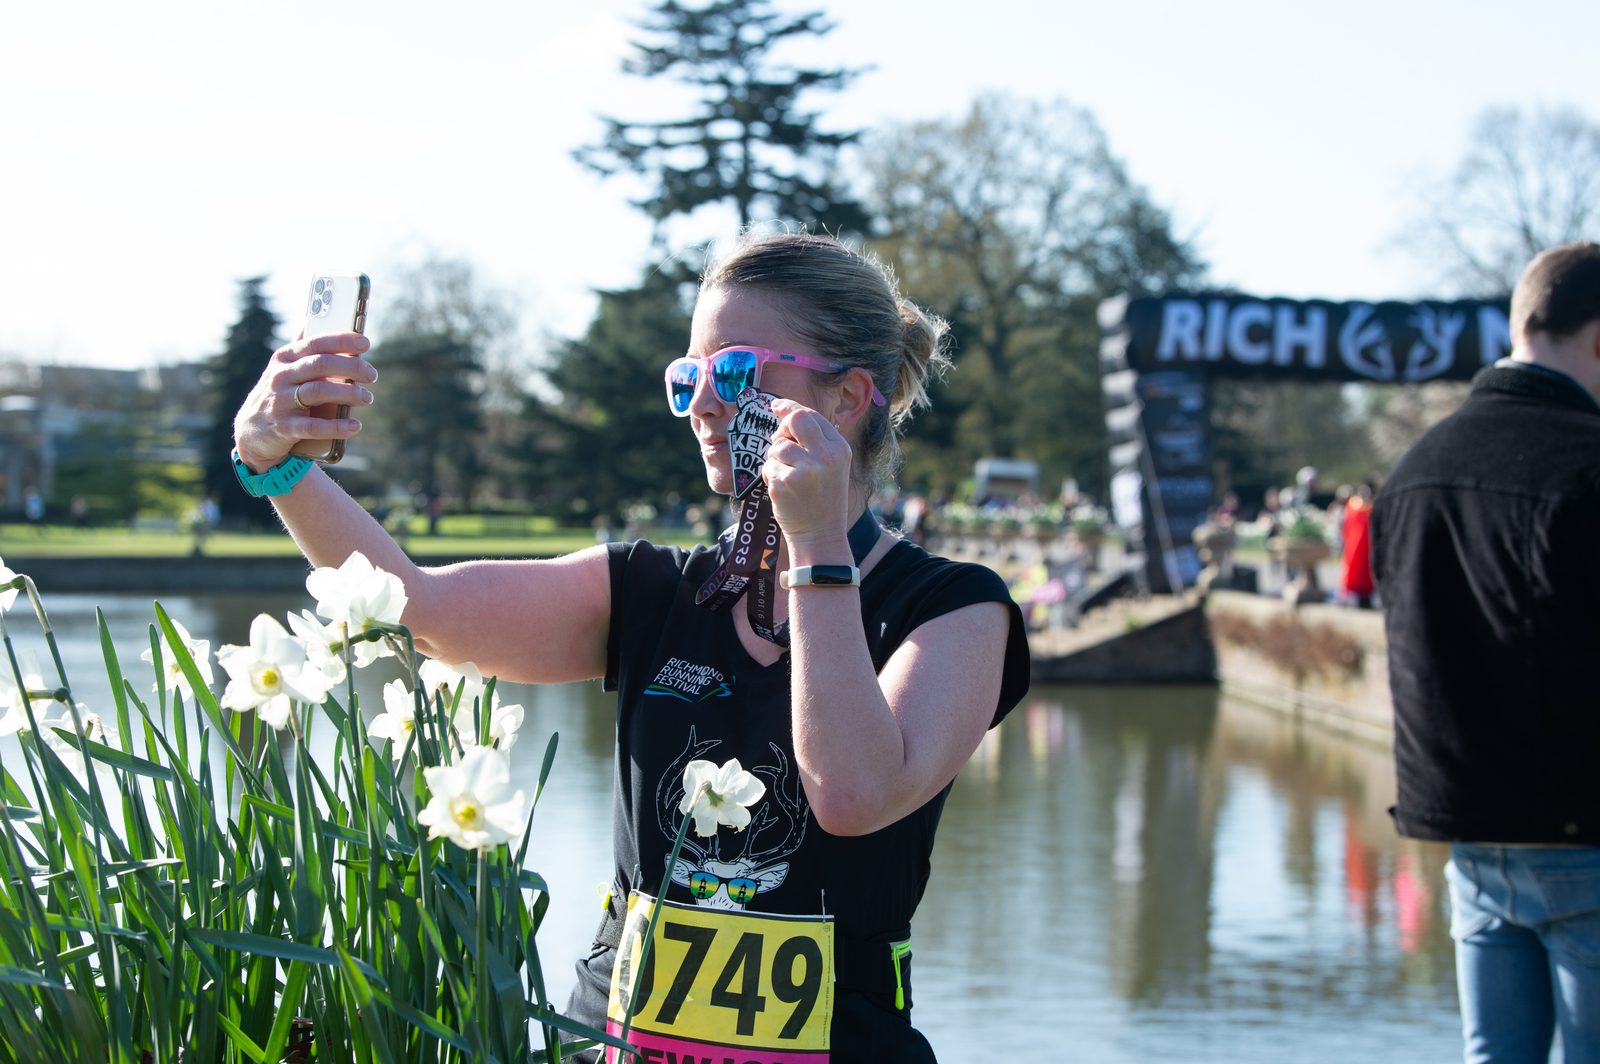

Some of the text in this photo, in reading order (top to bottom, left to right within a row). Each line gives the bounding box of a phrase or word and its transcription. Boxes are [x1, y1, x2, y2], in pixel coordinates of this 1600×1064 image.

[1156, 301, 1328, 369] RICH
[735, 452, 765, 476] 10K
[735, 482, 762, 566] UTDOORS
[659, 665, 713, 686] RUNNING
[666, 656, 724, 682] RICHMOND
[653, 673, 701, 695] FESTIVAL
[618, 912, 824, 1040] 0749
